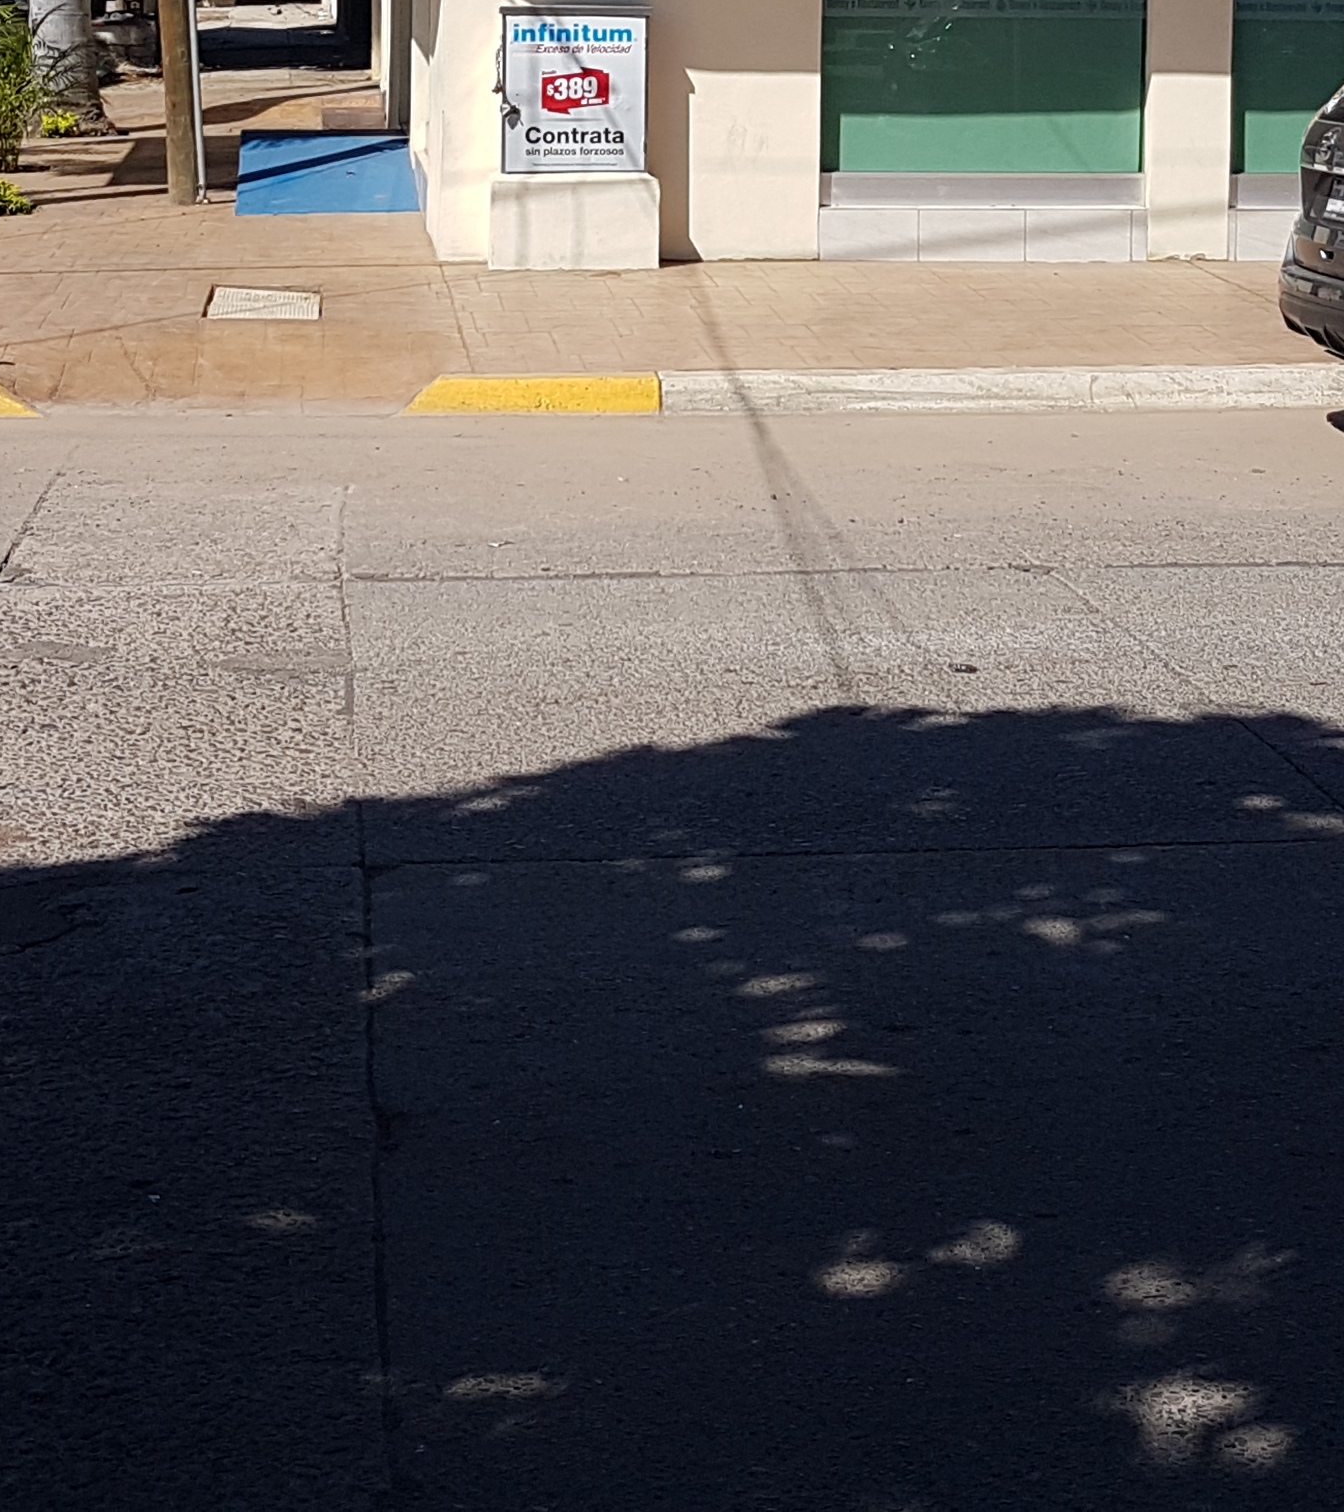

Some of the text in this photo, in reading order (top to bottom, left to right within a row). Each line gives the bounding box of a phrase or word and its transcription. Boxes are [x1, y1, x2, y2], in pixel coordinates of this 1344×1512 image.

[513, 23, 632, 42] infinitum
[535, 43, 633, 54] Exceso de Velocidad
[546, 76, 598, 100] $389
[525, 126, 624, 144] Contrata
[525, 146, 624, 157] sin plazos forzosos
